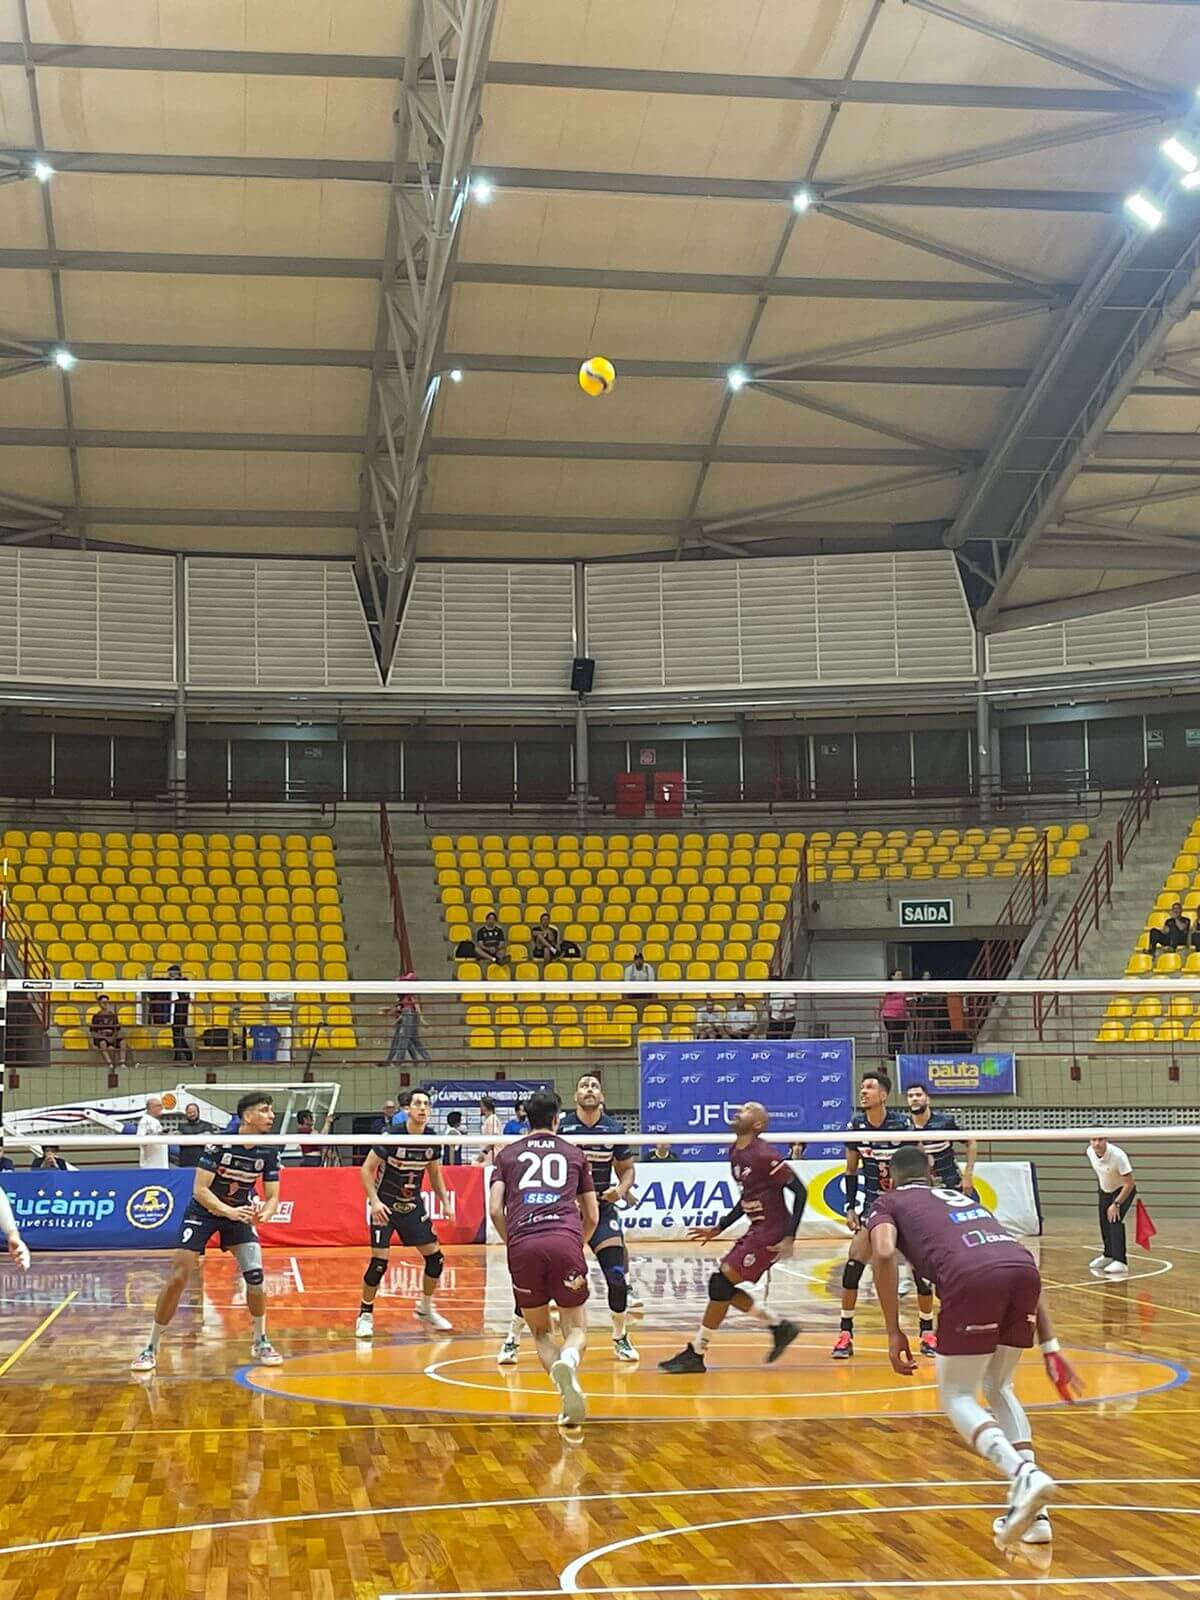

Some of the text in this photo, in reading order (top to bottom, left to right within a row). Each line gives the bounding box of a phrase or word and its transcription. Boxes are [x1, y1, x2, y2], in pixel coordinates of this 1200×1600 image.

[904, 904, 948, 921] SAÍDA
[928, 1062, 979, 1080] pauta
[688, 1101, 740, 1126] JFt
[527, 1140, 555, 1149] PILAN
[517, 1152, 568, 1190] 20
[931, 1189, 977, 1208] 9
[14, 1217, 94, 1228] niversitário
[661, 1211, 672, 1227] é
[682, 1211, 719, 1227] vid
[181, 1227, 193, 1243] 9
